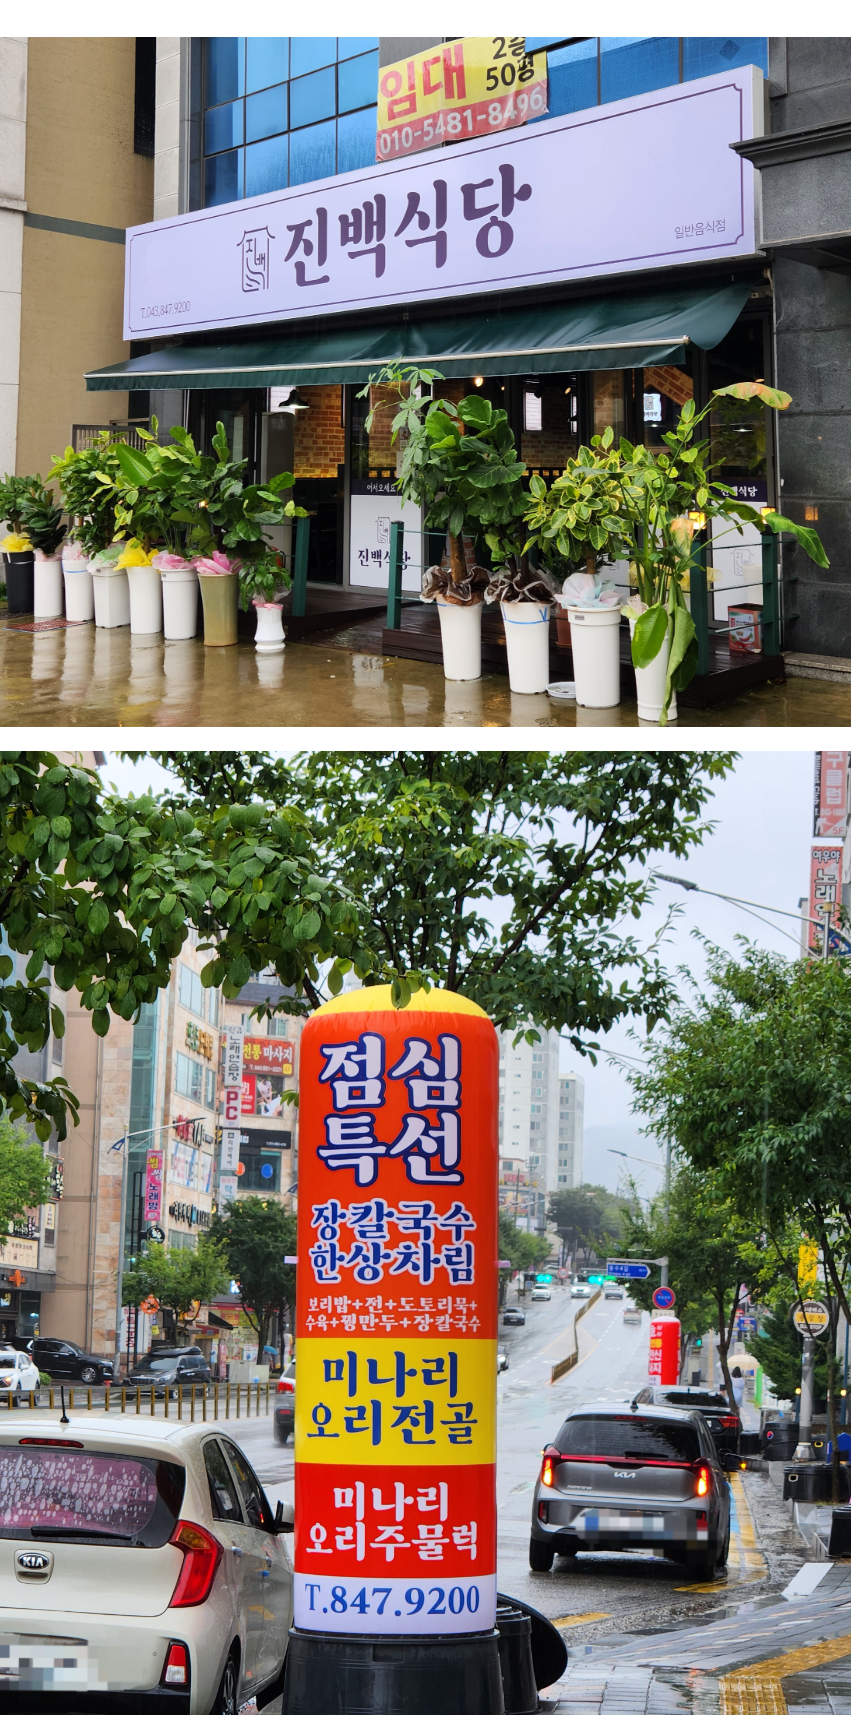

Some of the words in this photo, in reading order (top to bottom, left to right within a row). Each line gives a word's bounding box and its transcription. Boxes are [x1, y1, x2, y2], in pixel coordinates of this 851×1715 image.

[380, 43, 467, 121] 임대
[380, 86, 544, 154] 010-5481-8496
[284, 163, 532, 287] 진백식당
[674, 218, 726, 239] 일반음식점
[366, 482, 396, 493] 어서오세요
[812, 849, 841, 864] 여우야
[228, 1036, 241, 1082] 노래연습장
[244, 1043, 262, 1060] 전통
[263, 1045, 293, 1064] 마사지
[319, 1032, 462, 1110] 점심
[317, 1110, 463, 1187] 특선
[148, 1183, 159, 1211] 노래방
[312, 1199, 476, 1242] 장칼국수
[310, 1242, 475, 1285] 한상차림
[308, 1295, 478, 1314] 보리밥+전+도토리묵+
[323, 1351, 458, 1398] 미나리
[307, 1399, 478, 1446] 오리전골
[614, 1471, 636, 1479] KIA
[333, 1481, 448, 1522] 미나리
[22, 1555, 45, 1568] KIA
[306, 1521, 478, 1562] 오리주물럭
[305, 1583, 480, 1617] T.847.9200
